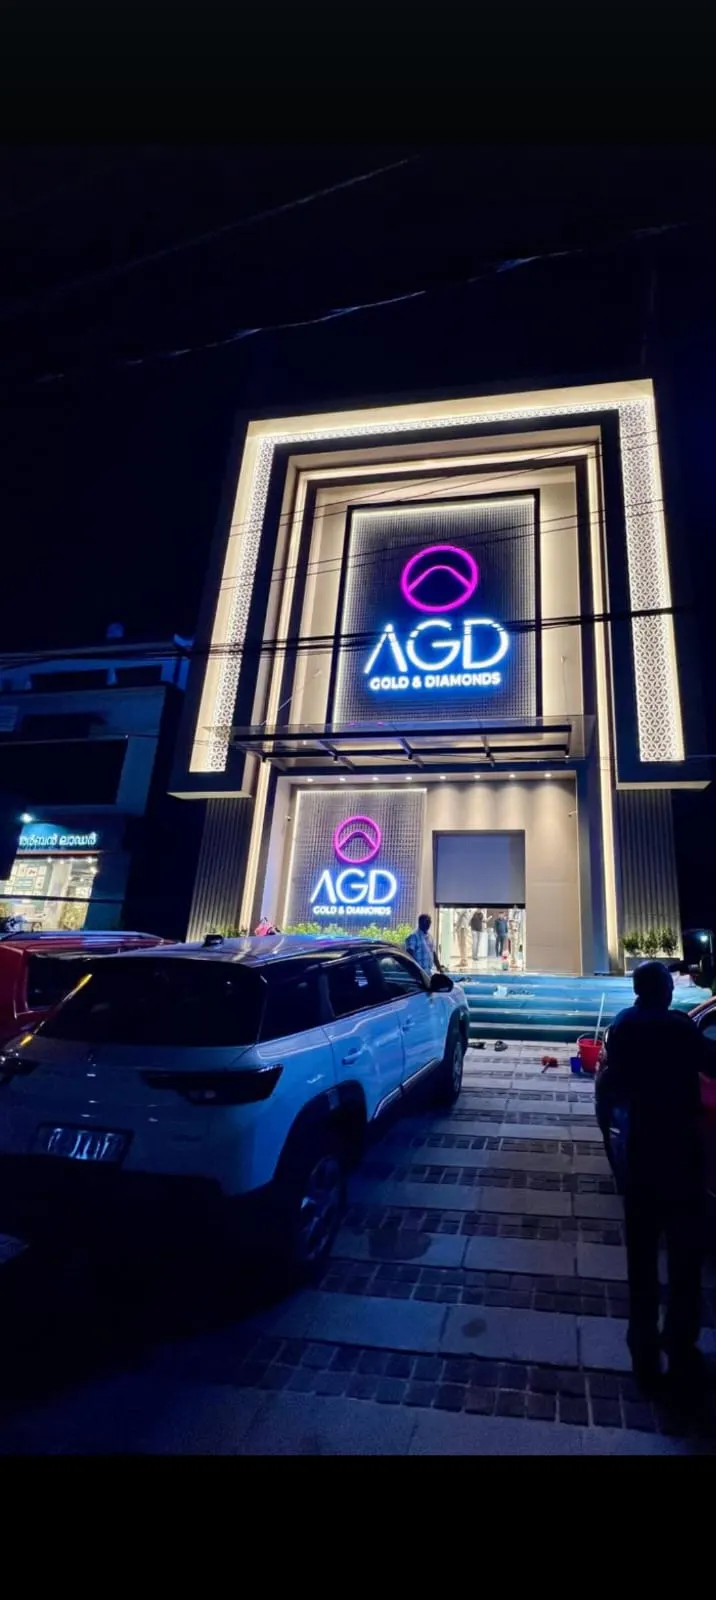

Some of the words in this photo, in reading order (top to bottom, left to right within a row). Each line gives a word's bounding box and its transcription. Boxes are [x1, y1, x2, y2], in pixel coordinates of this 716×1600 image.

[364, 619, 509, 673] AGD
[370, 677, 409, 690] GOLD
[412, 676, 422, 688] &
[424, 673, 501, 687] DIAMONDS
[310, 869, 397, 904] AGD
[313, 906, 337, 915] GOLD
[338, 906, 345, 915] &
[346, 906, 391, 915] DIAMONDS
